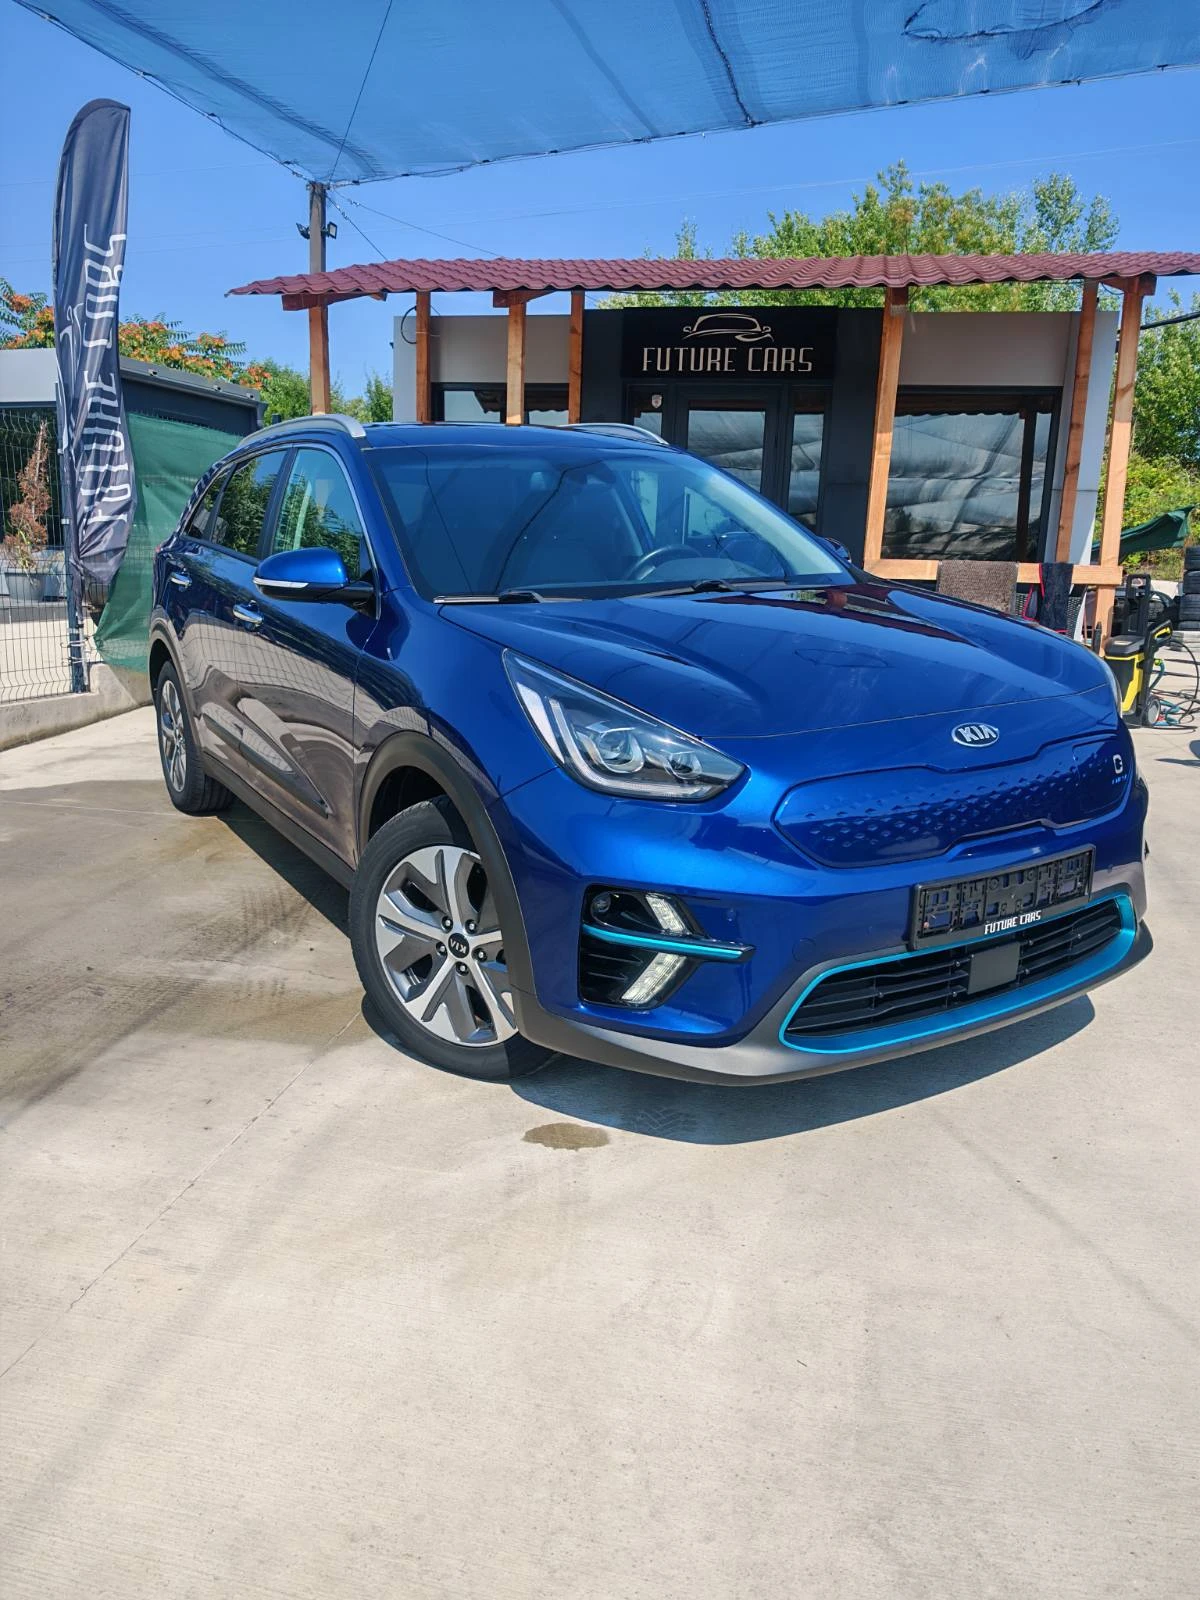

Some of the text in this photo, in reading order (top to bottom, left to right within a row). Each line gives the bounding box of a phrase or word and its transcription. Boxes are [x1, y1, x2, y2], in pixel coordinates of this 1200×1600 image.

[642, 347, 814, 372] FUTURE CARS
[79, 223, 132, 531] FUTURE CARS
[957, 724, 997, 742] KIA
[984, 910, 1041, 934] FUTURE CARS
[450, 938, 467, 954] KIA
